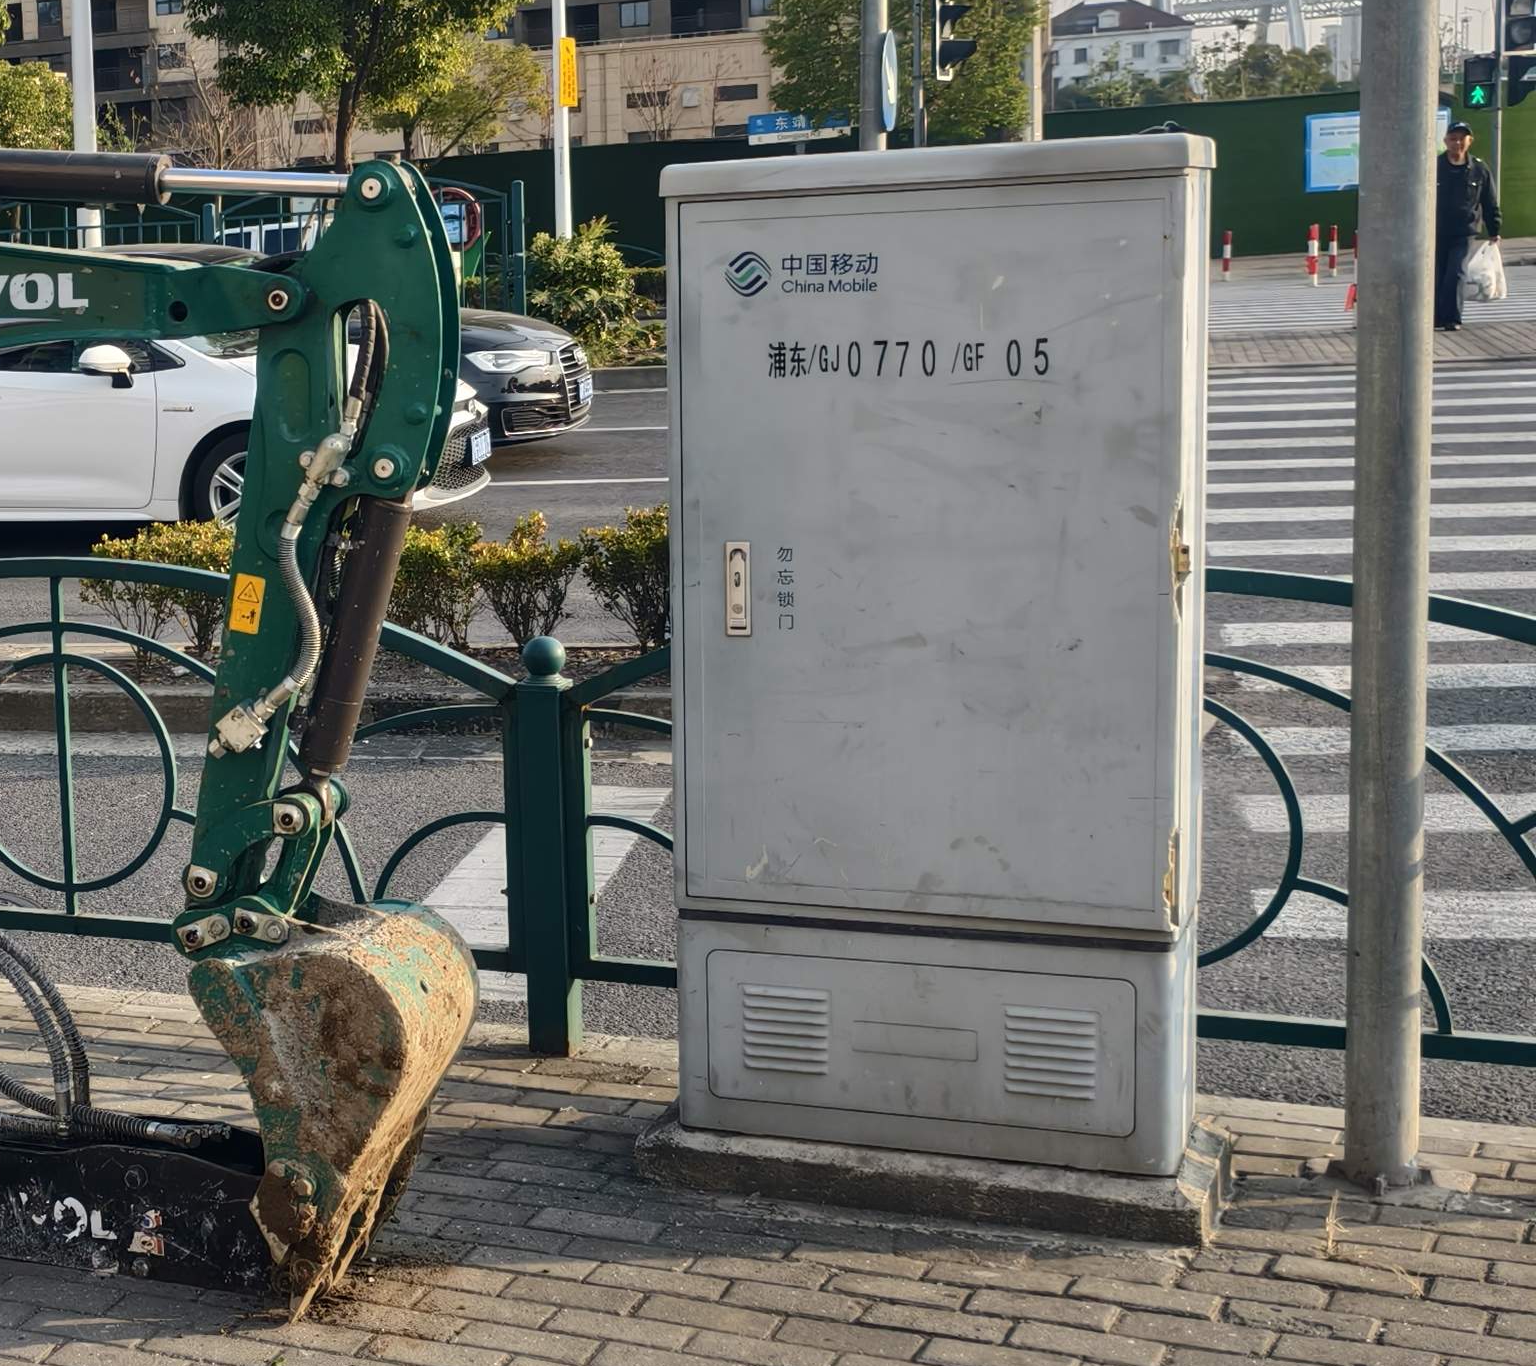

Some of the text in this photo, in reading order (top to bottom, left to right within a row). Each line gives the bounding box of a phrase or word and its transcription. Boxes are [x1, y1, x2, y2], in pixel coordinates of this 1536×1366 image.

[775, 115, 815, 131] 东靖
[781, 252, 879, 276] 中国移动
[781, 278, 878, 294] China Mobile
[776, 546, 795, 630] 勿忘锁门
